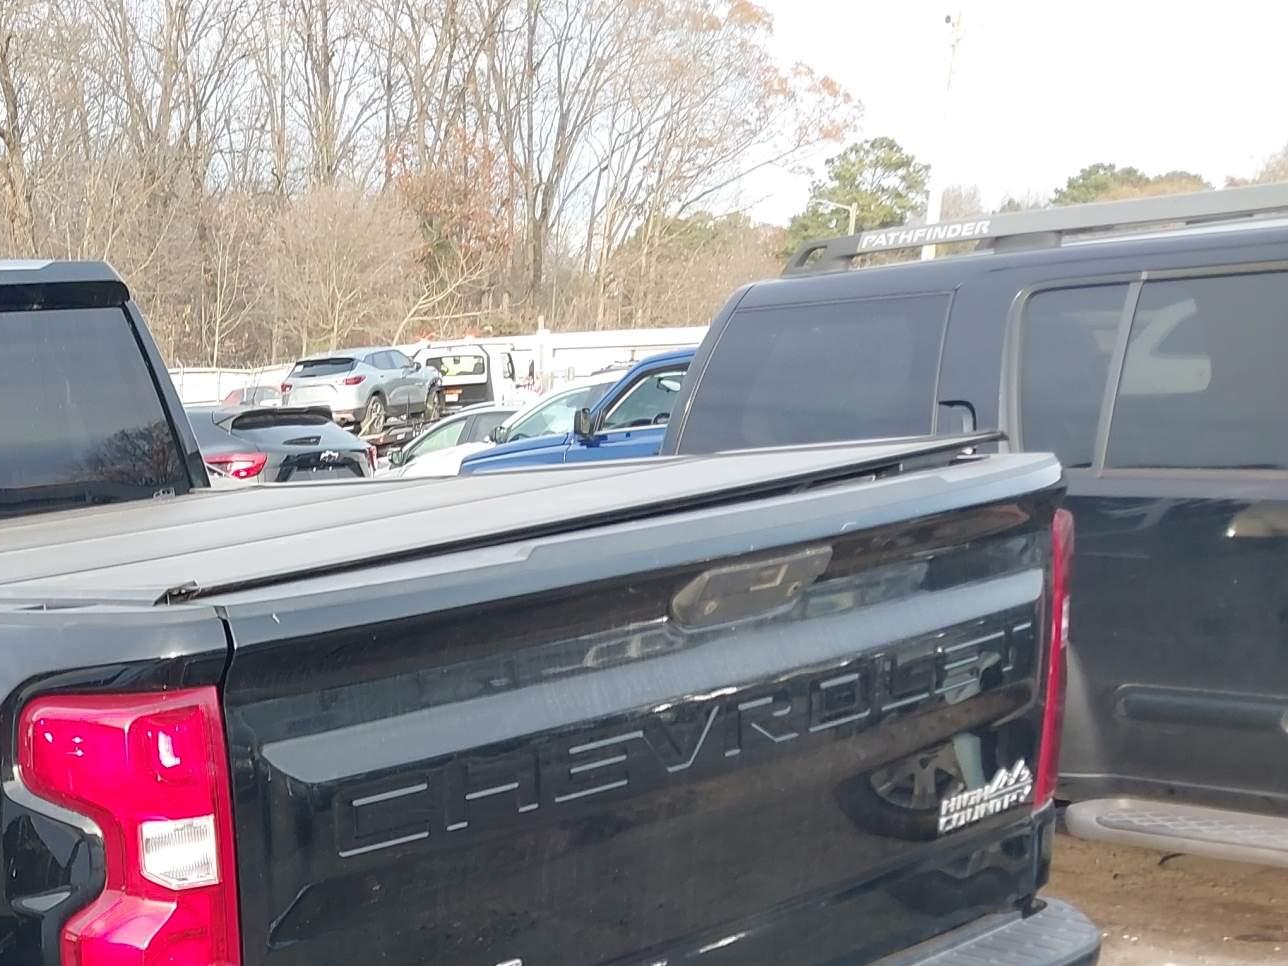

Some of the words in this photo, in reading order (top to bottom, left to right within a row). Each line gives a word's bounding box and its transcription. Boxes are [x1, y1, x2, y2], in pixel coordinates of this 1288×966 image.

[861, 220, 991, 249] PATHFINDER
[337, 620, 1034, 859] CHEVROLET
[938, 784, 1033, 833] COUNTRY
[940, 784, 992, 816] HIGH
